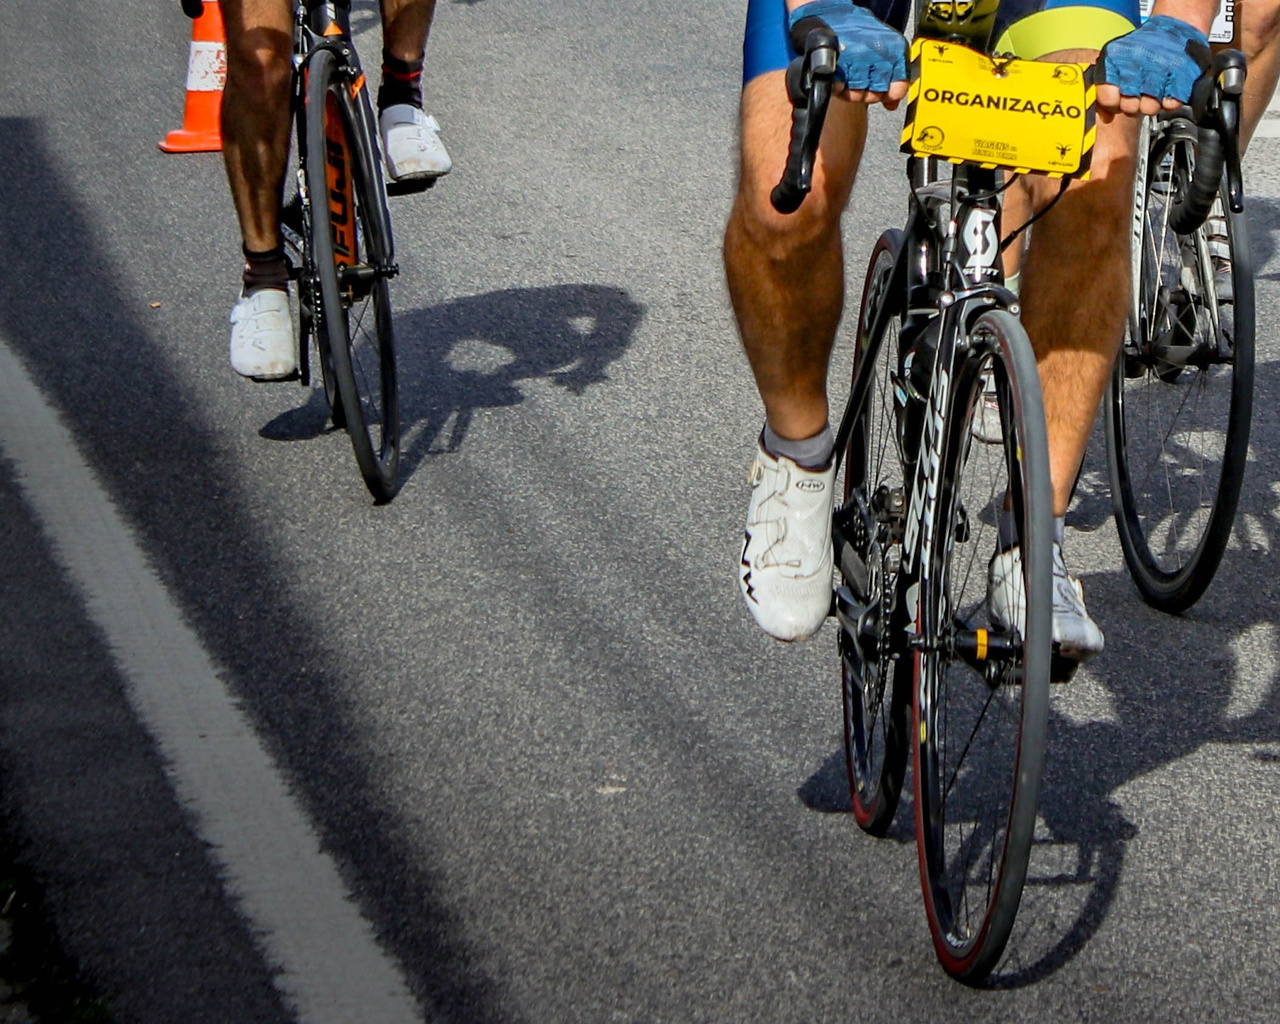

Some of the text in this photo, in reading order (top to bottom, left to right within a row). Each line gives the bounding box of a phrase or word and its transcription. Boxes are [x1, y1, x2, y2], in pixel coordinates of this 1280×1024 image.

[924, 88, 1081, 120] ORGANIZAÇÃO
[326, 137, 350, 257] FUJI
[1133, 157, 1146, 245] SCOTT
[921, 368, 947, 580] SCOTT
